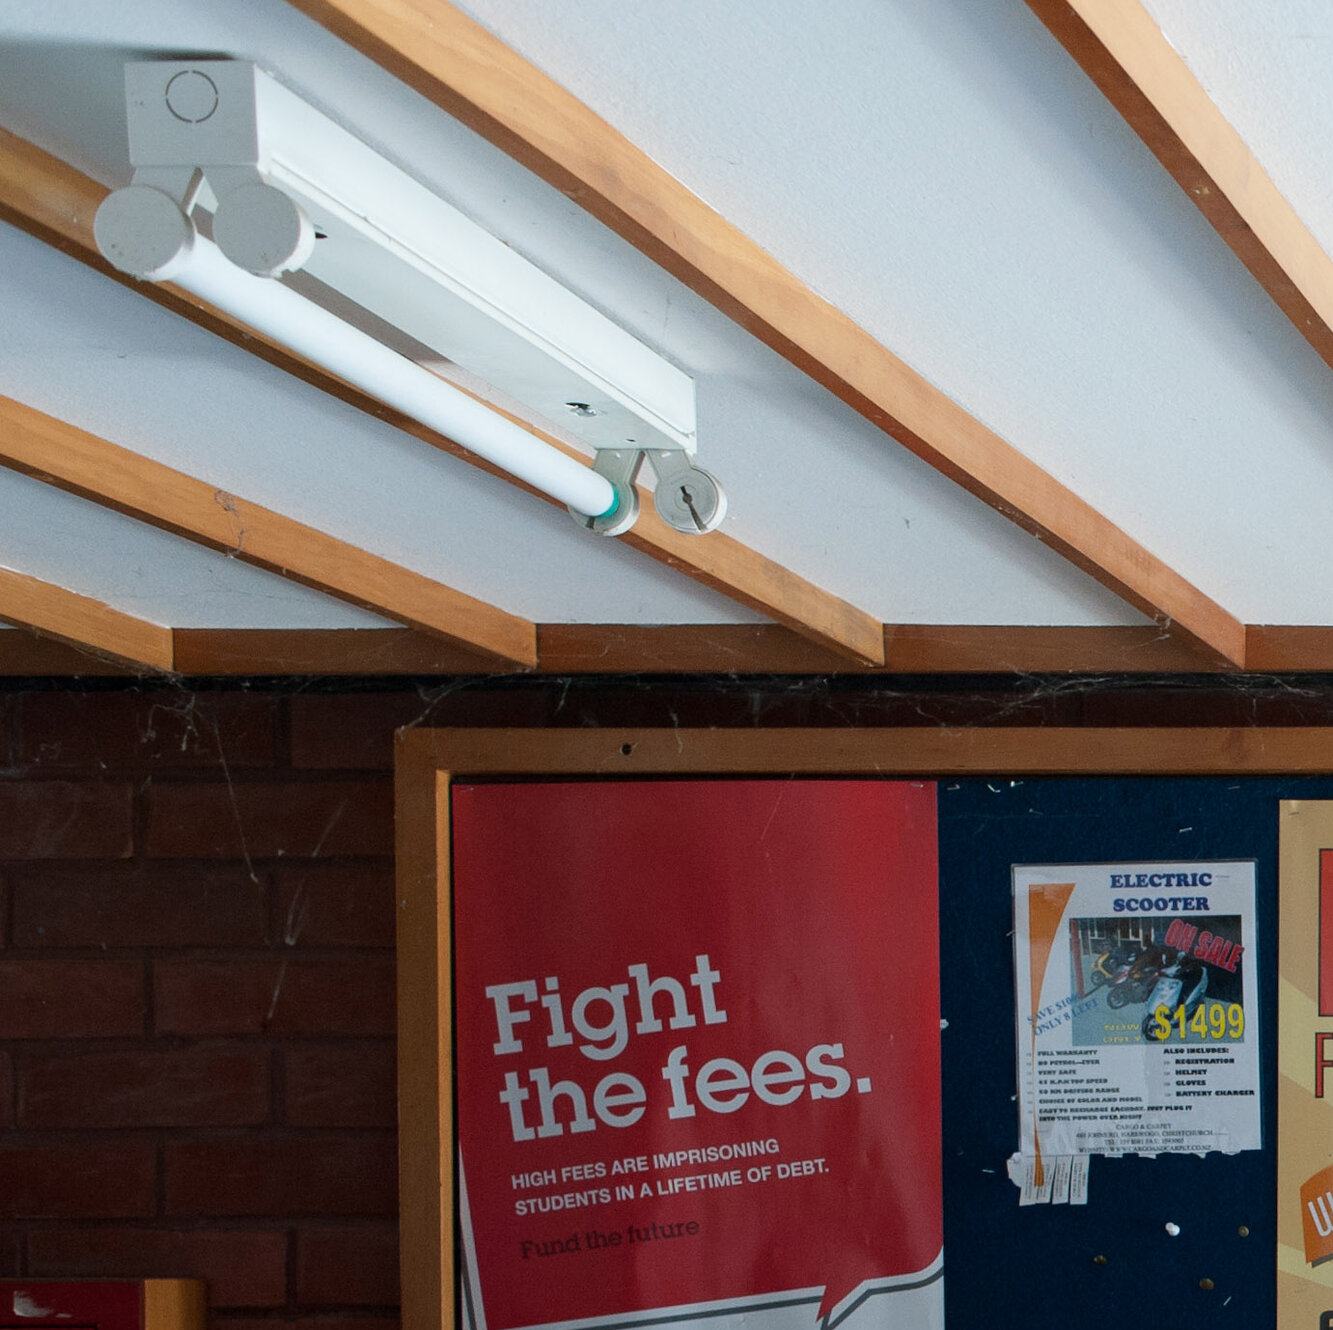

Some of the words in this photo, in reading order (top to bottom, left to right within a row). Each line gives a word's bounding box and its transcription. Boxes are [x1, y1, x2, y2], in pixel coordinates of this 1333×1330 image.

[1110, 873, 1212, 888] ELECTRIC
[1113, 897, 1209, 912] SCOOTER
[1164, 918, 1198, 950] ON
[1194, 930, 1245, 974] SALE
[485, 954, 727, 1055] Fight
[1154, 1003, 1245, 1043] $1499
[501, 1067, 646, 1141] the
[661, 1043, 871, 1119] fees.
[511, 1169, 556, 1189] HIGH
[561, 1162, 606, 1182] FEES
[611, 1156, 649, 1175] ARE
[653, 1138, 779, 1168] IMPRISONING
[515, 1188, 611, 1215] STUDENTS
[615, 1184, 634, 1200] IN
[640, 1182, 653, 1198] A
[657, 1170, 742, 1195] LIFETIME
[747, 1166, 771, 1182] OF
[777, 1158, 829, 1178] DEBT.
[519, 1232, 581, 1259] Fund
[585, 1230, 622, 1250] the
[626, 1221, 699, 1244] future
